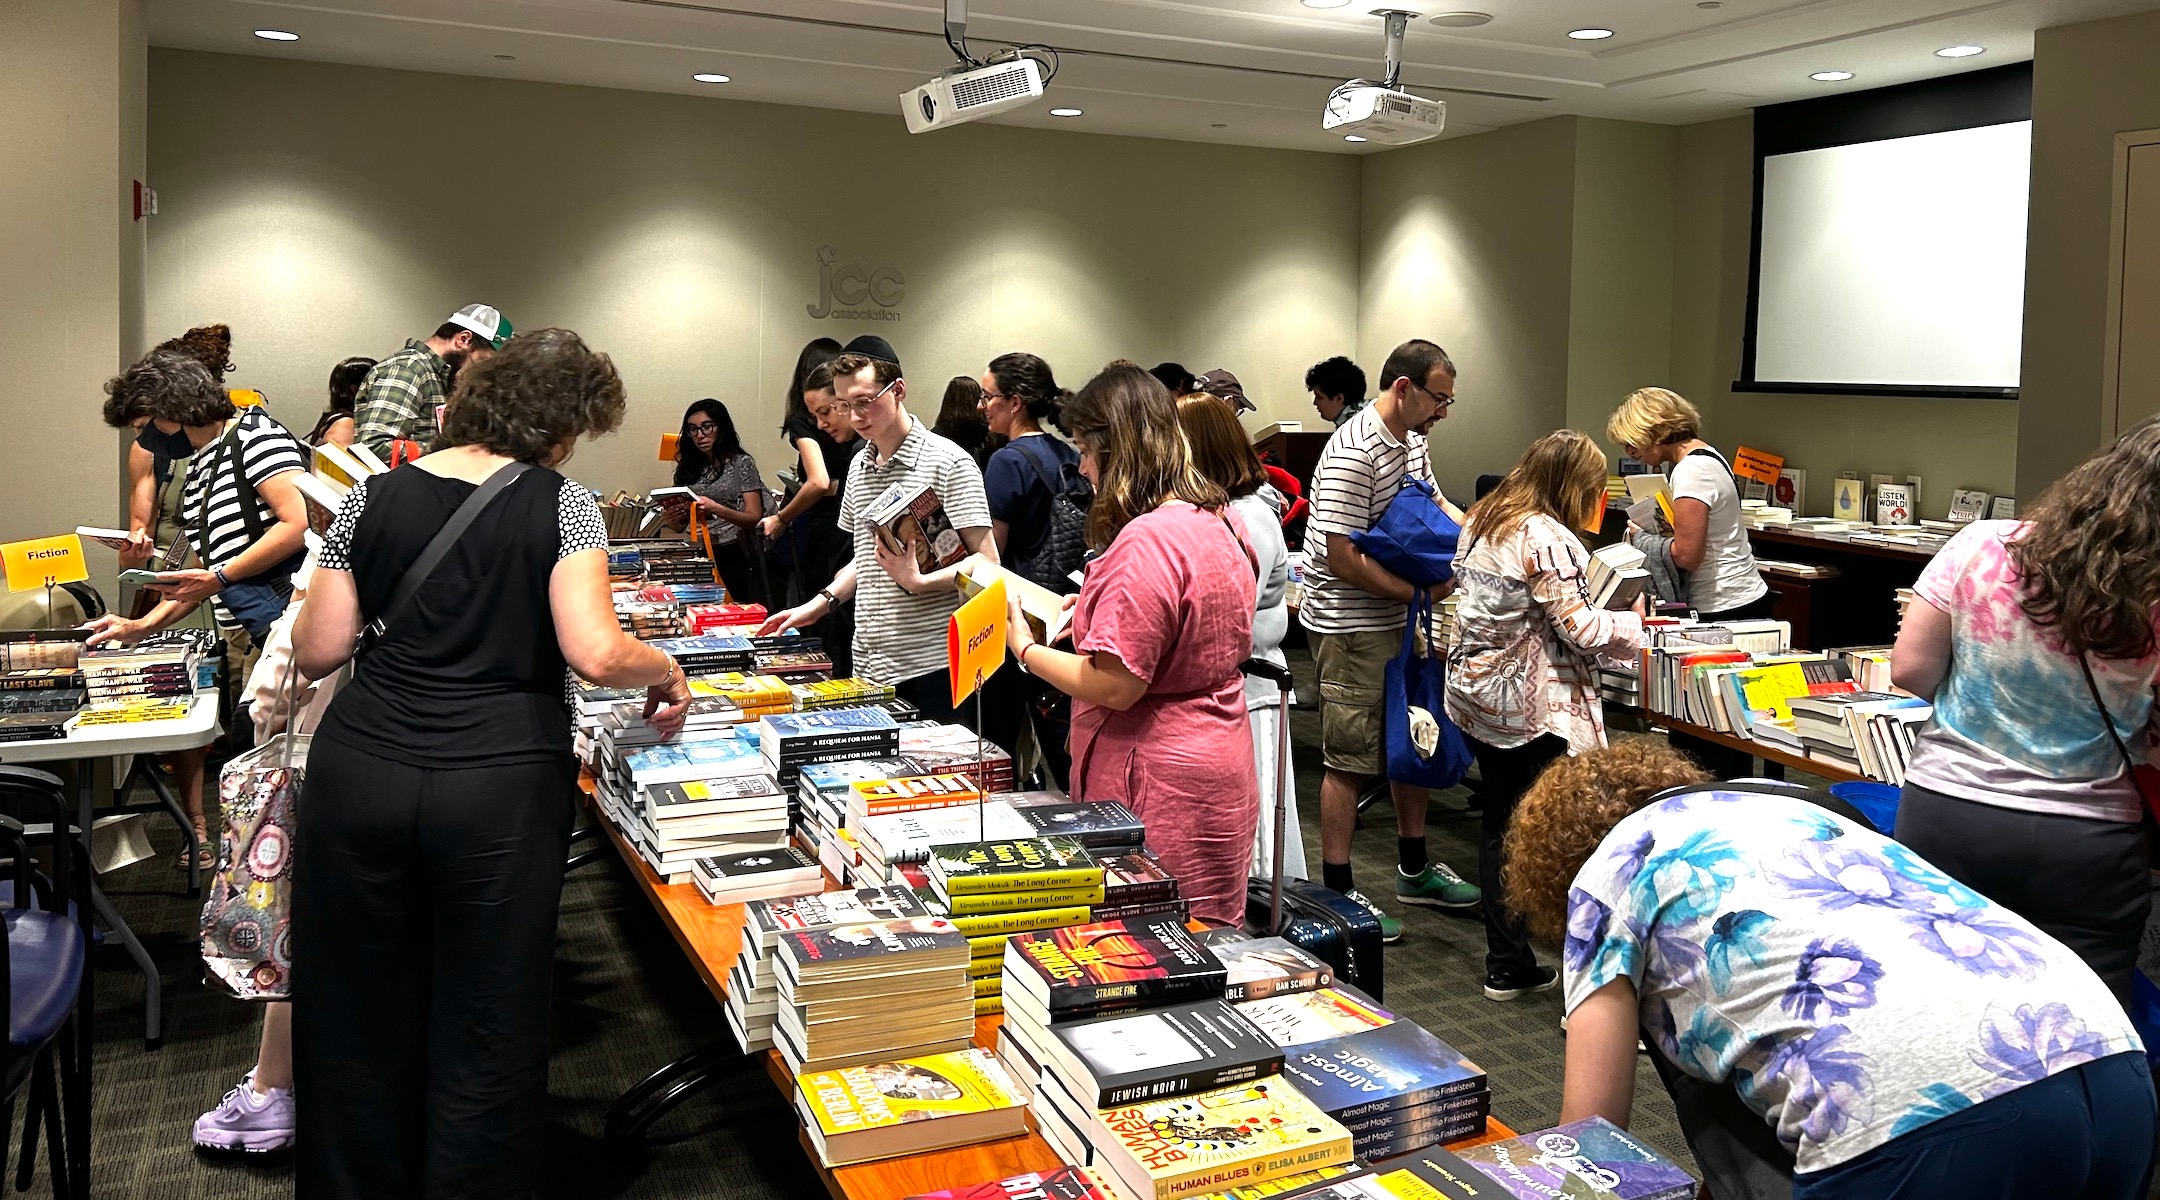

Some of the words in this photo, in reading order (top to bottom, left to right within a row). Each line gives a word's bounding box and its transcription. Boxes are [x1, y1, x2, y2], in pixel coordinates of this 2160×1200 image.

[806, 244, 905, 319] jcc
[831, 309, 901, 321] association
[1738, 453, 1781, 470] Autobiography
[1749, 464, 1771, 475] Memoir
[28, 547, 69, 560] Fiction
[967, 623, 994, 655] Fiction
[86, 668, 123, 678] HANNAH'S
[124, 667, 141, 675] WAR
[4, 681, 26, 690] LAST
[28, 679, 55, 688] SLAVE
[89, 678, 124, 687] HANNAH'S
[126, 677, 143, 685] WAR
[91, 687, 127, 696] HANNAH'S
[129, 686, 146, 694] WAR
[3, 700, 20, 708] SAY
[819, 737, 847, 746] REQUIEM
[819, 753, 847, 763] REQUIEM
[955, 883, 986, 891] Alexander
[988, 881, 1010, 889] Maksik
[1027, 879, 1045, 887] Long
[1047, 877, 1071, 885] Corner
[959, 901, 990, 909] Alexander
[992, 899, 1014, 907] Maksik
[1030, 896, 1049, 904] Long
[1050, 893, 1074, 902] Corner
[1102, 910, 1120, 919] BRIDGE
[1127, 908, 1140, 916] LOVE
[1144, 906, 1160, 914] DAVID
[1161, 904, 1173, 912] BIRD
[1003, 920, 1015, 928] The
[1016, 919, 1034, 928] Long
[1036, 916, 1060, 924] Corner
[1023, 938, 1085, 979] STRANGE
[1095, 986, 1123, 999] STRANGE
[1125, 984, 1138, 996] FIRE
[1275, 981, 1289, 992] DAN
[1290, 977, 1317, 989] SCHORR
[1300, 1052, 1384, 1093] Almost
[1334, 1049, 1402, 1090] Magic
[816, 1075, 839, 1086] of
[840, 1067, 894, 1123] SHADOWS
[1110, 1085, 1148, 1103] JEWISH
[1152, 1080, 1176, 1096] NOIR
[1180, 1078, 1188, 1090] II
[819, 1088, 862, 1127] BERLIN
[1342, 1104, 1368, 1118] Almost
[1369, 1100, 1391, 1114] Magic
[1419, 1087, 1440, 1099] Phillip
[1441, 1081, 1476, 1095] Finkelstein
[1349, 1120, 1370, 1131] lmost
[1371, 1115, 1393, 1128] Magic
[1422, 1105, 1442, 1117] Phillip
[1443, 1096, 1478, 1111] Finkelstein
[1128, 1107, 1188, 1163] BLUES
[1353, 1134, 1373, 1146] most
[1373, 1129, 1395, 1142] Magic
[1422, 1119, 1442, 1131] Phillip
[1444, 1109, 1479, 1124] Finkelstein
[1100, 1111, 1169, 1170] HUMAN
[1369, 1144, 1391, 1158] Magic
[1419, 1133, 1440, 1145] Phillip
[1441, 1124, 1475, 1139] Finkelstein
[1171, 1175, 1211, 1194] HUMAN
[1214, 1167, 1250, 1183] BLUES
[1268, 1158, 1295, 1172] ELISA
[1297, 1149, 1332, 1166] ALBERT
